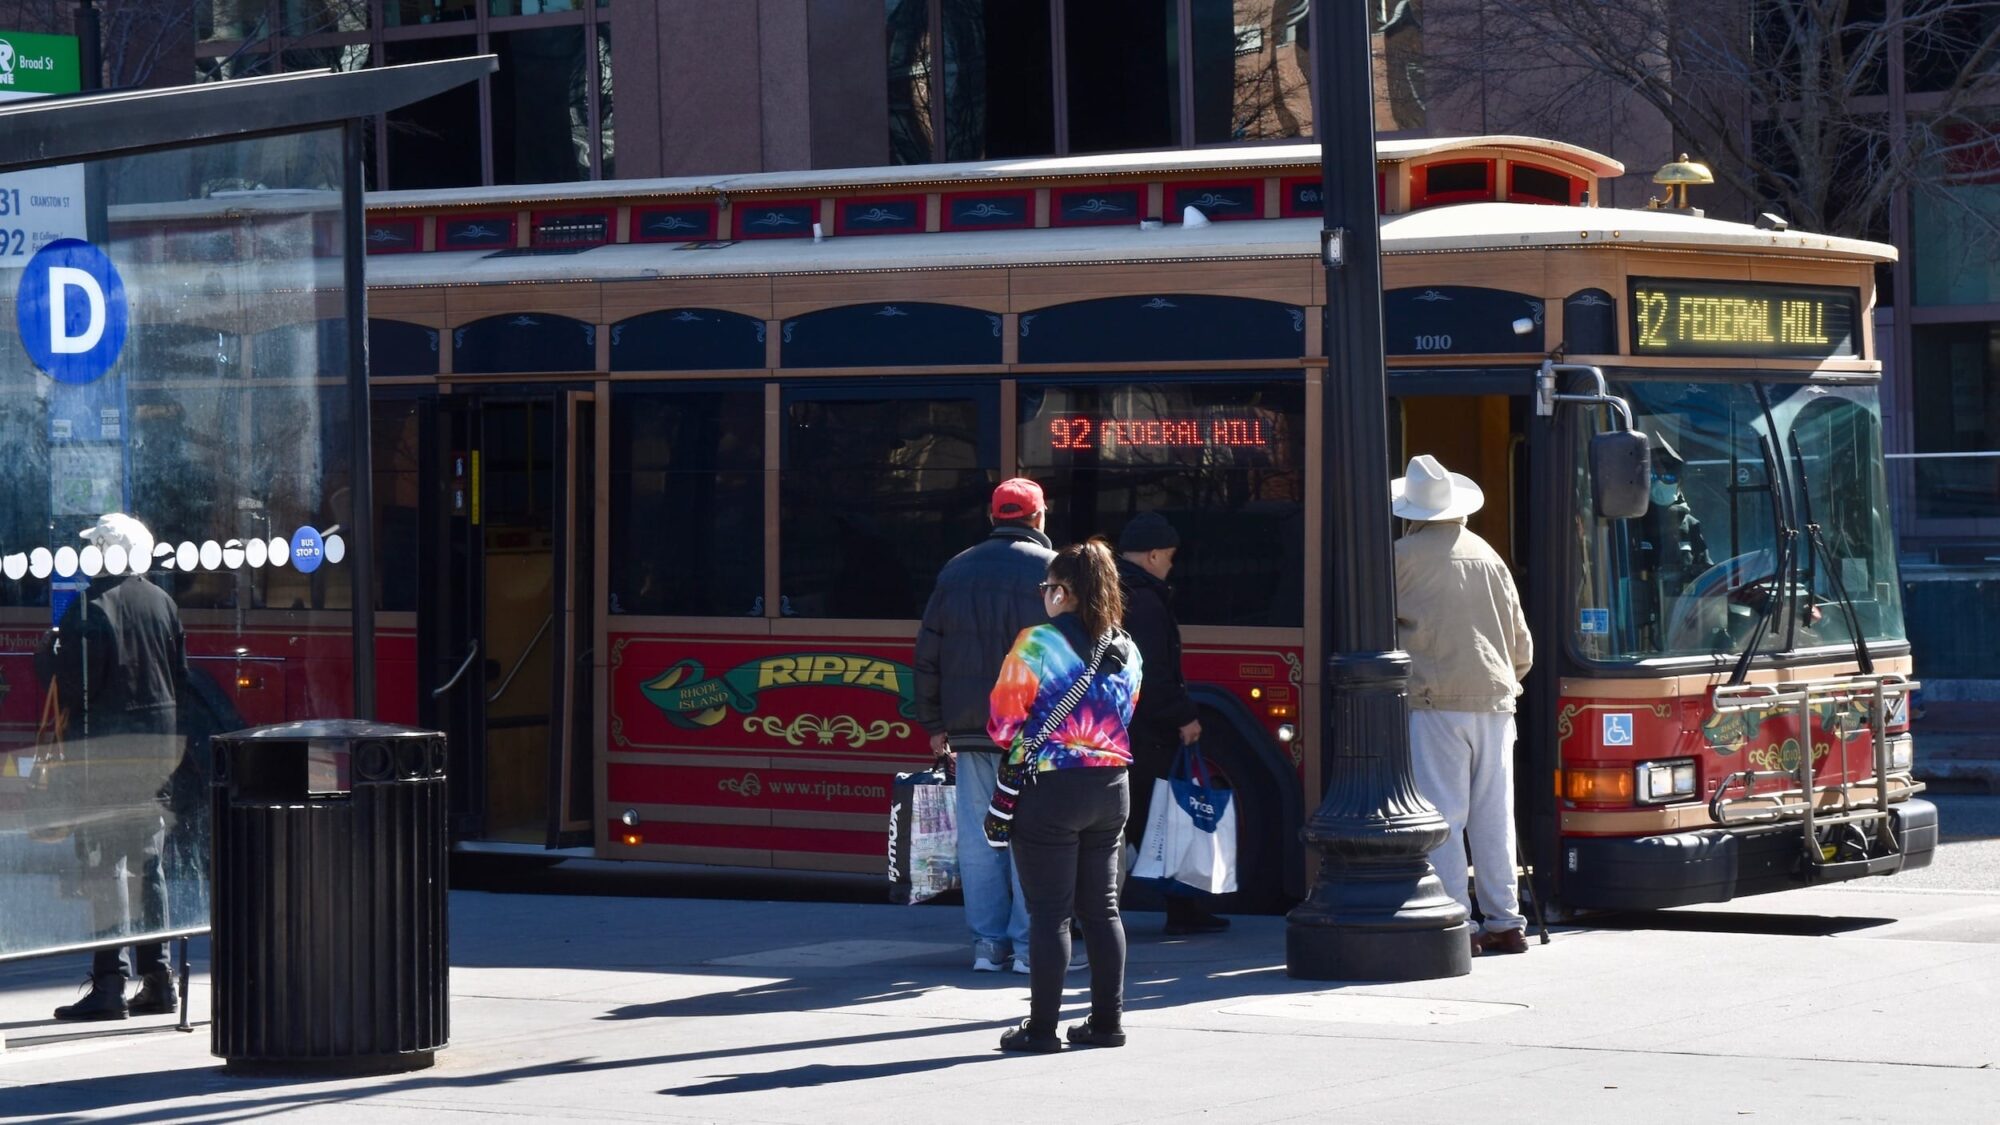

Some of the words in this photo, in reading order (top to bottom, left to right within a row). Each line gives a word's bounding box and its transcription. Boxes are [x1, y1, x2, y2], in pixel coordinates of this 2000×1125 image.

[20, 55, 43, 70] Broad
[45, 57, 53, 71] St
[30, 195, 61, 208] CRANSTON
[63, 196, 70, 208] ST
[48, 265, 107, 354] D
[1678, 296, 1775, 342] FEDERAL
[1781, 300, 1829, 344] HILL
[1413, 334, 1453, 350] 1010
[1050, 418, 1092, 449] 92
[1101, 420, 1204, 446] FEDERAL
[1213, 420, 1266, 446] HILL
[300, 538, 315, 547] BUS
[295, 548, 313, 557] STOP
[314, 547, 320, 556] D
[758, 655, 900, 693] RIPTA
[680, 682, 719, 700] RHODE
[680, 692, 729, 710] ISLAND
[768, 780, 886, 801] www.ripta.com
